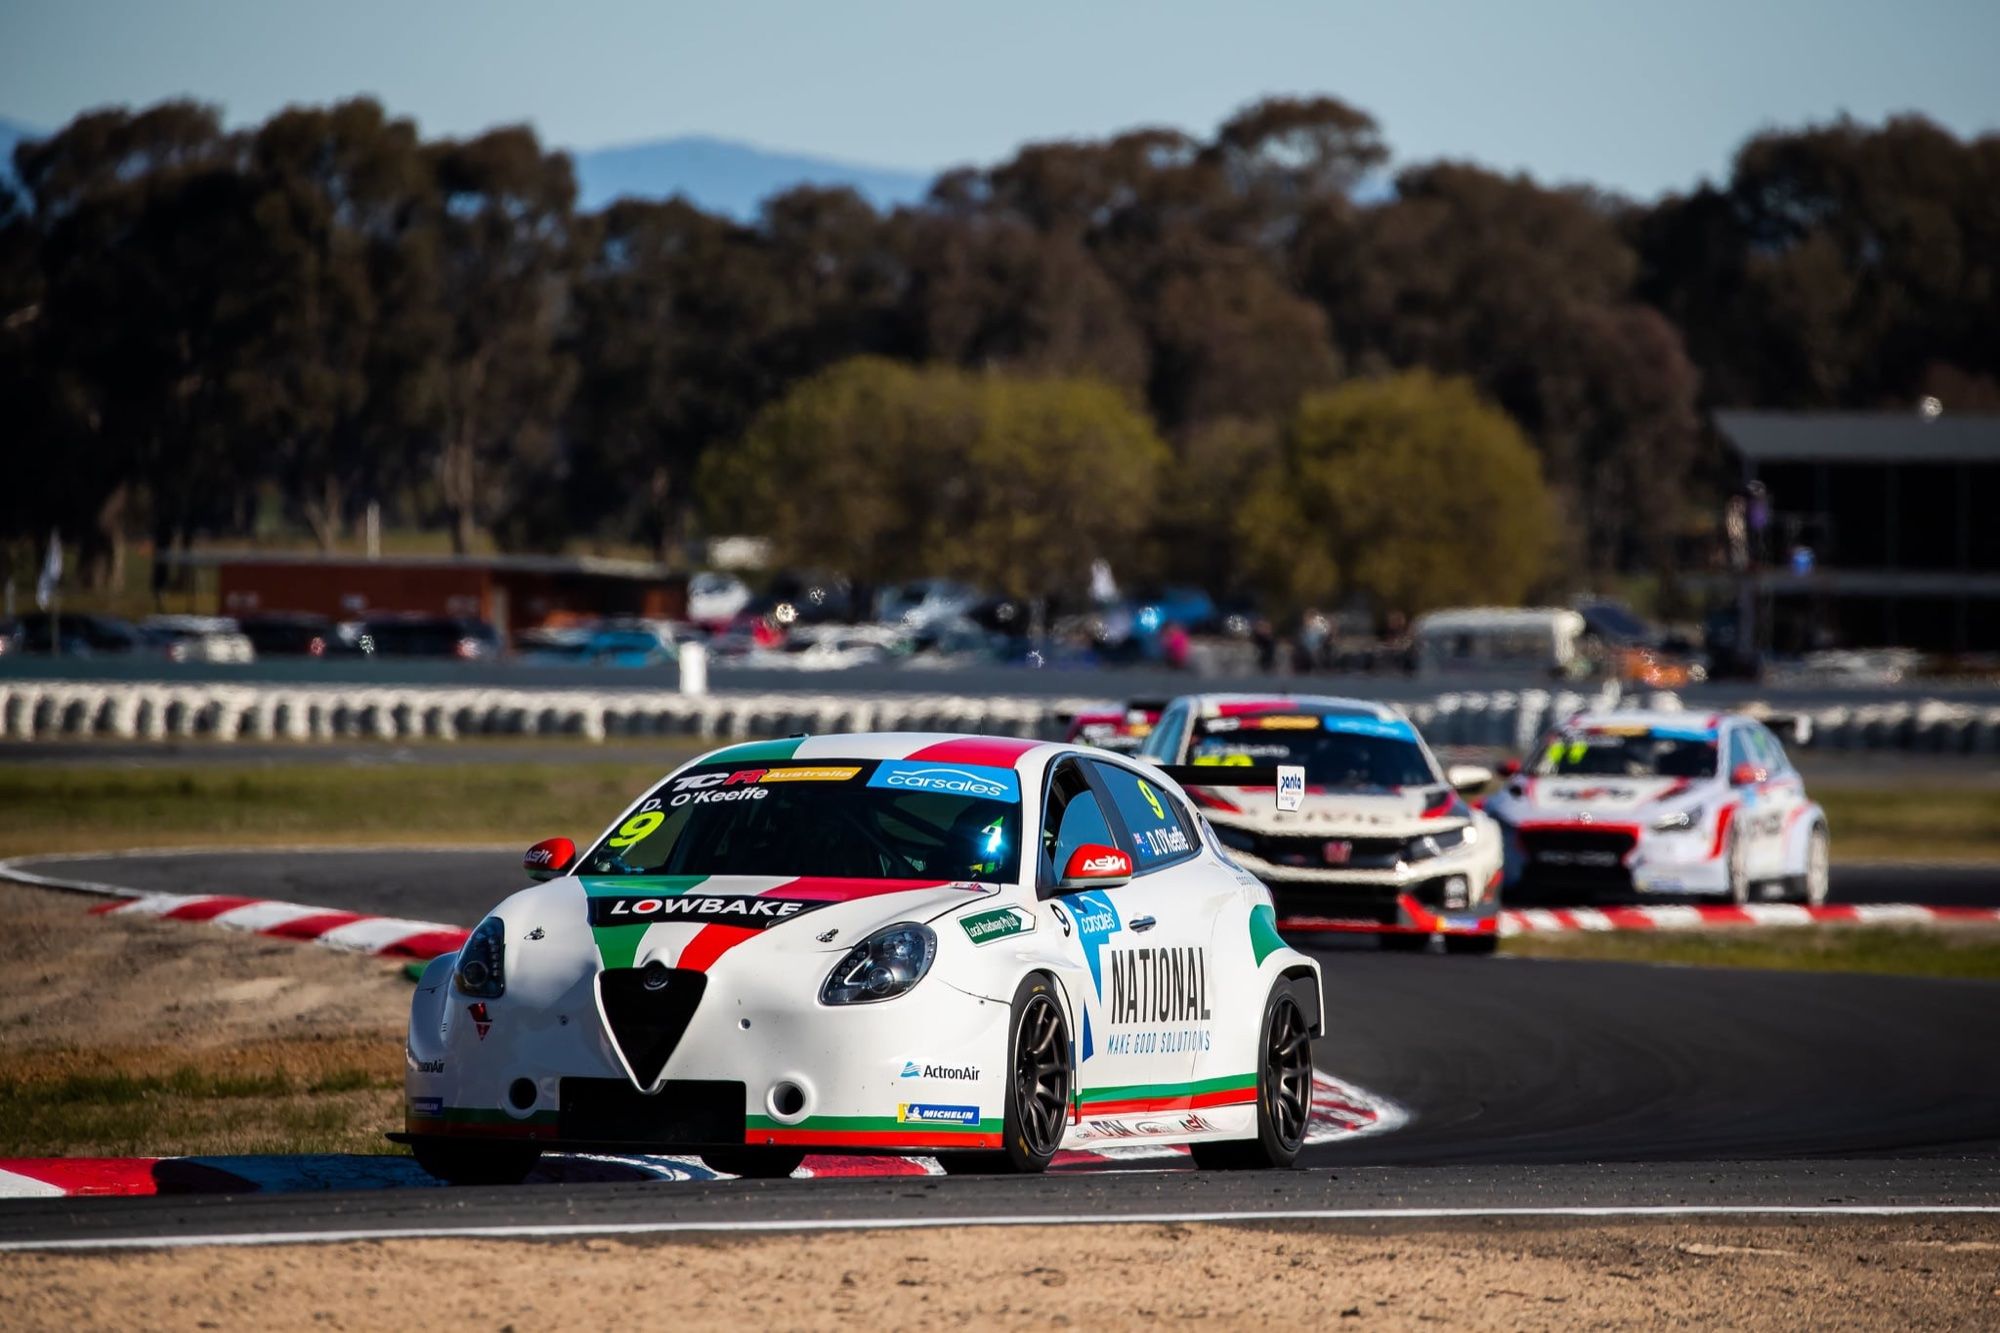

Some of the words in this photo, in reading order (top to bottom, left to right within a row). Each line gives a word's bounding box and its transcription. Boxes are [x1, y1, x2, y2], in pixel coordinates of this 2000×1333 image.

[672, 769, 767, 792] TCR
[768, 769, 854, 779] Australia
[887, 775, 1001, 797] carsales
[640, 798, 662, 813] D.
[670, 787, 769, 807] O'Keeffe
[1137, 779, 1165, 820] 9
[609, 811, 666, 847] 9
[1146, 831, 1162, 856] D.
[610, 898, 804, 917] LOWBAKE
[1050, 903, 1071, 938] 9
[1081, 911, 1116, 935] carsales
[1111, 947, 1211, 1024] NATIONAL
[1107, 1034, 1131, 1055] MAKE
[1134, 1032, 1157, 1054] GOOD
[1160, 1030, 1210, 1053] SOLUTIONS
[923, 1064, 980, 1081] ActronAir
[923, 1109, 974, 1120] MICHELIN
